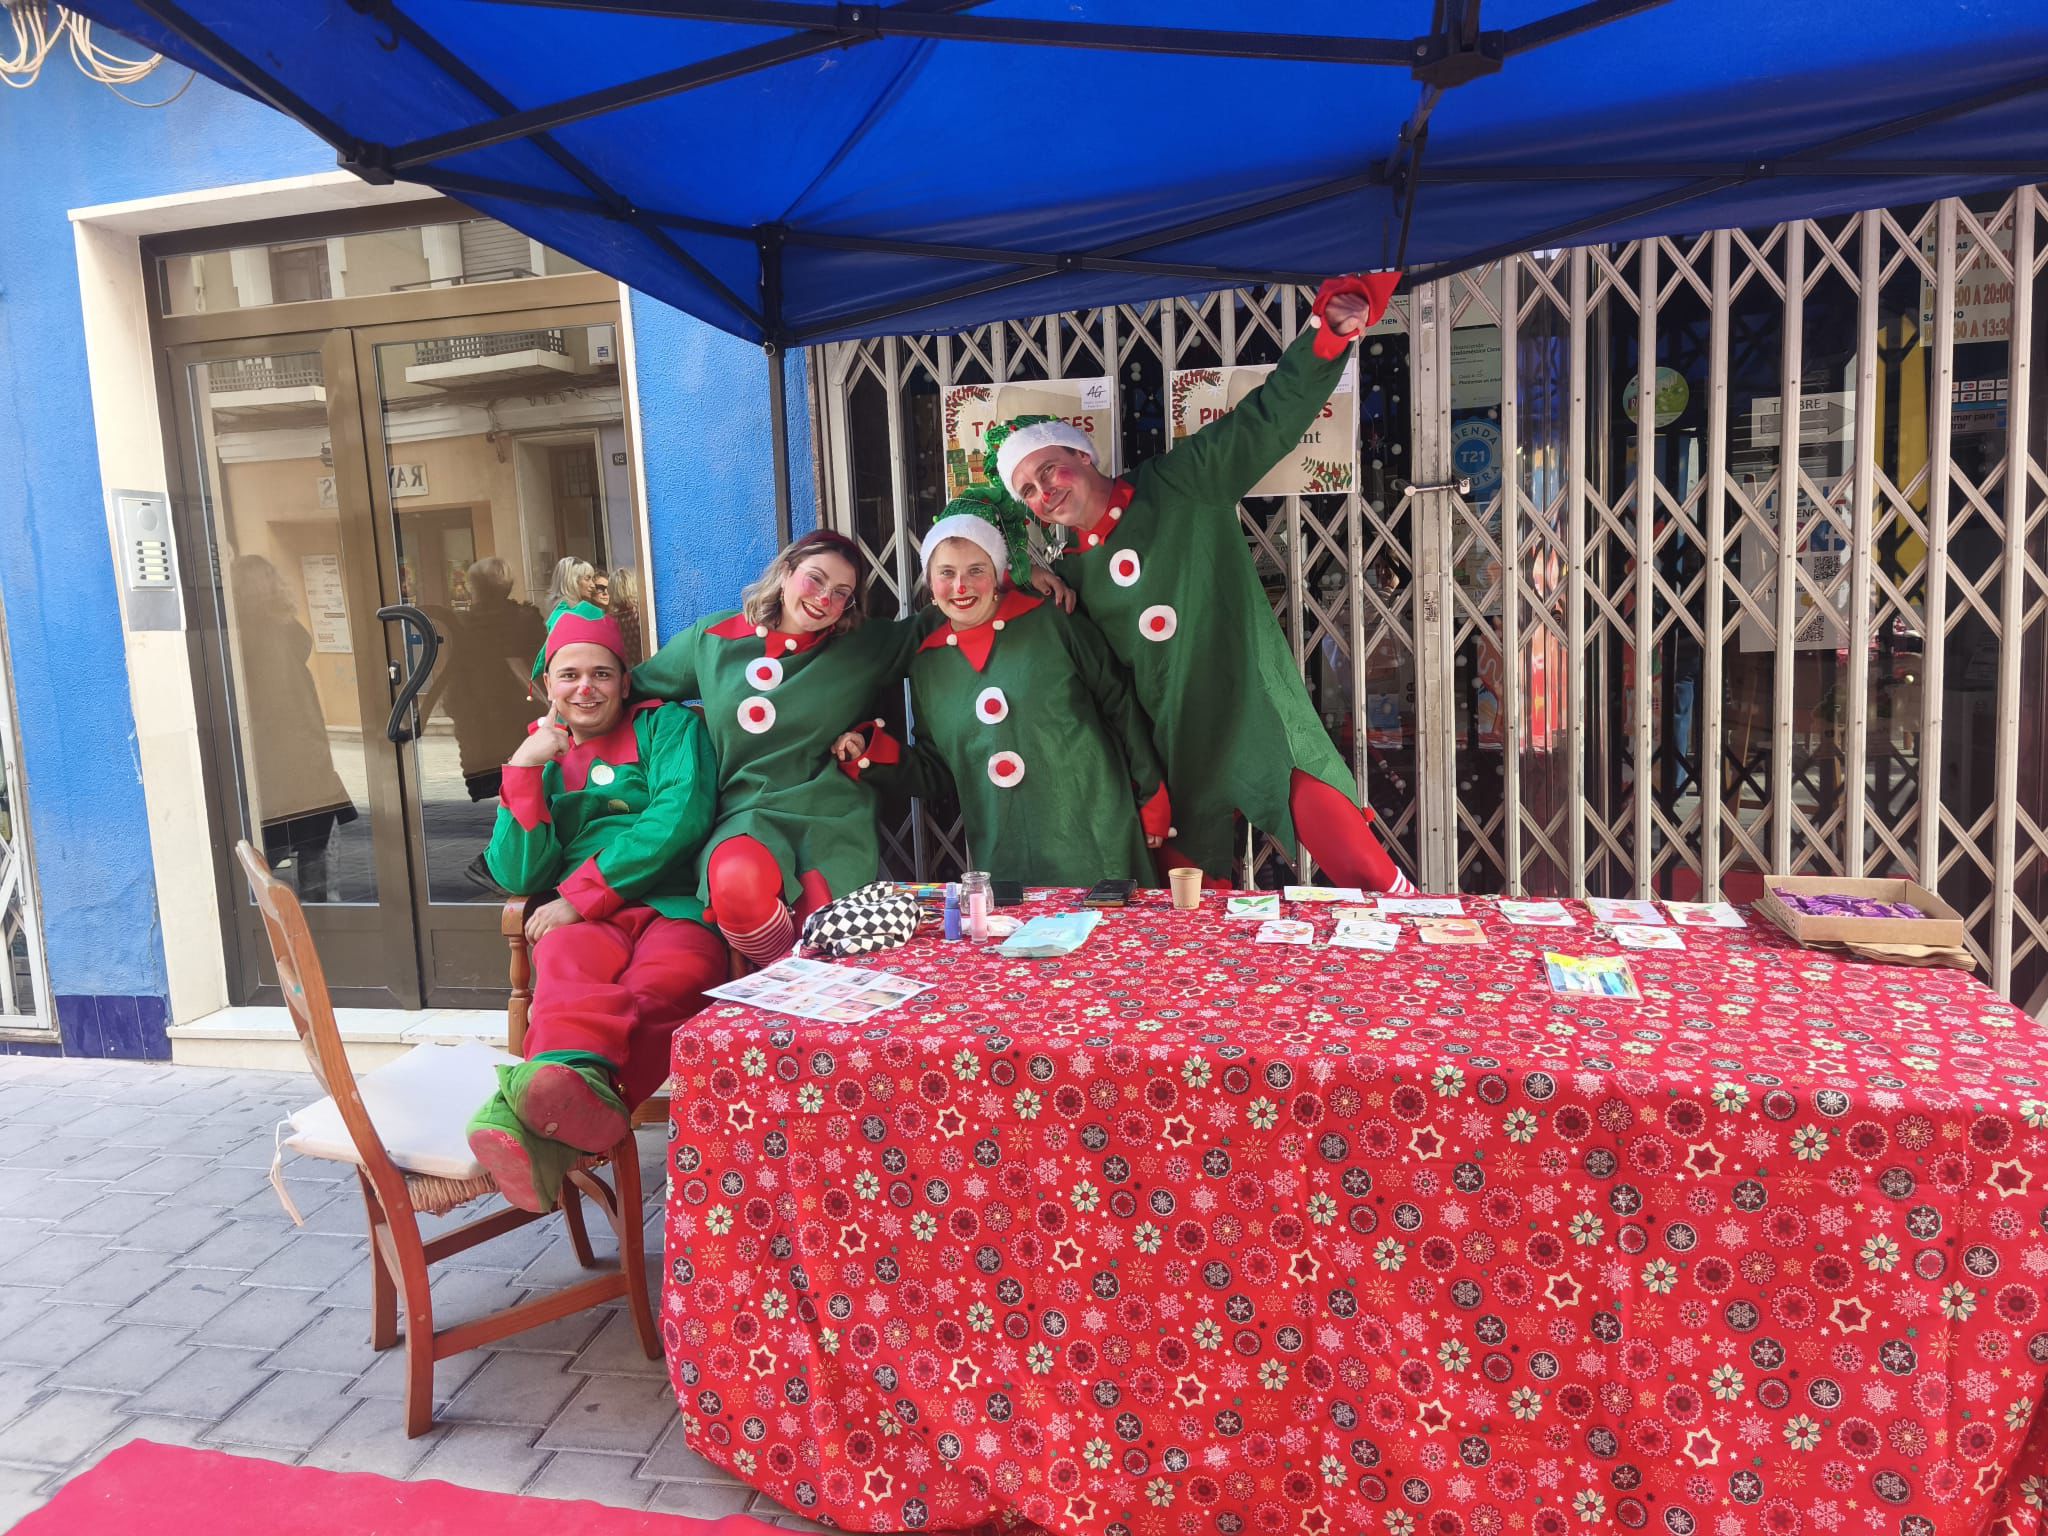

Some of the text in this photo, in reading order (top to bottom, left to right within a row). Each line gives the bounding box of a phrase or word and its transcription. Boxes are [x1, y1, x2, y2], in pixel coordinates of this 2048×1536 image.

[1973, 284, 1982, 306] A
[1970, 318, 1979, 338] A
[1772, 398, 1821, 413] TBRE
[1460, 450, 1485, 463] T21
